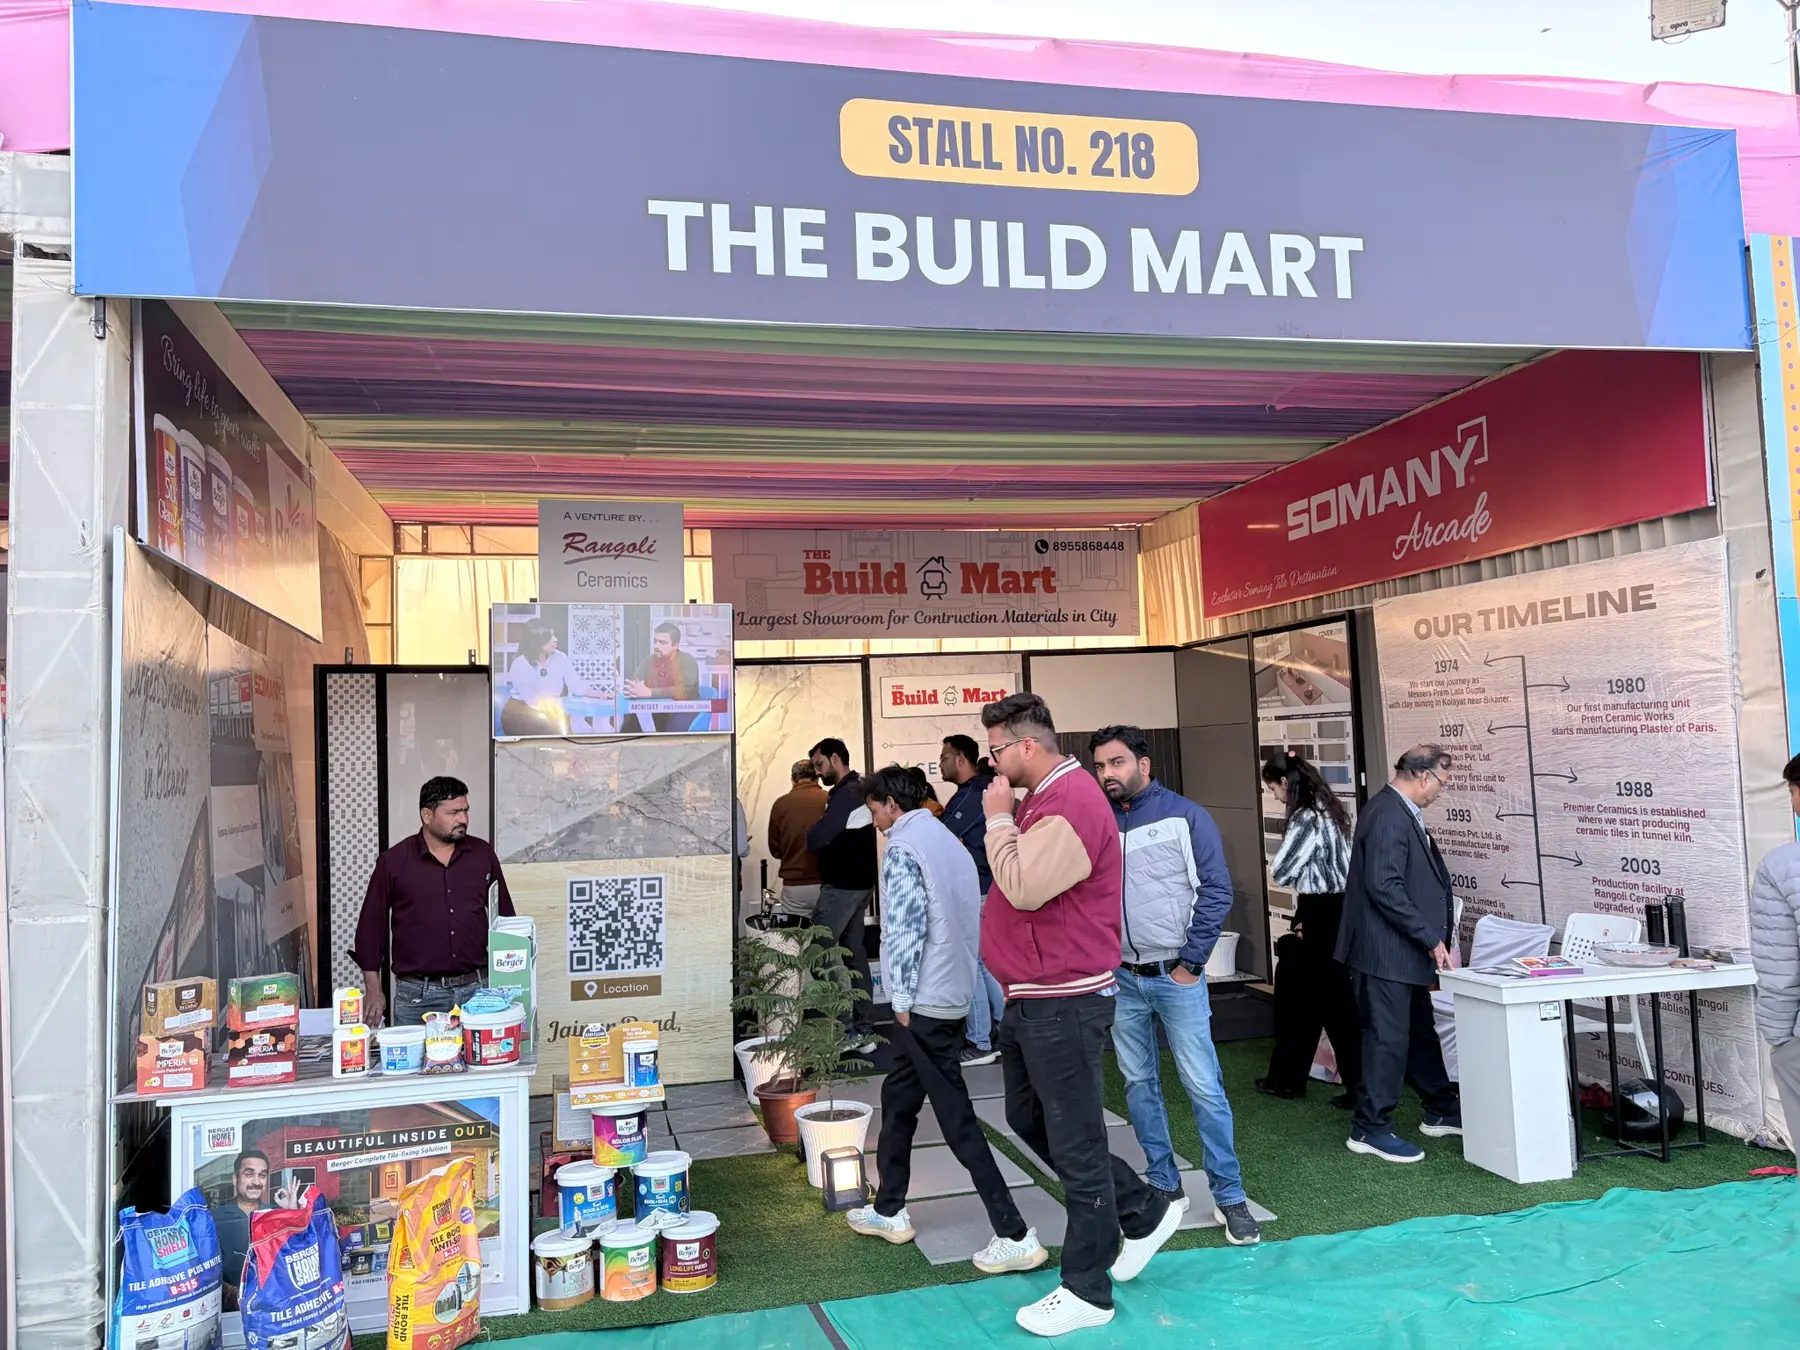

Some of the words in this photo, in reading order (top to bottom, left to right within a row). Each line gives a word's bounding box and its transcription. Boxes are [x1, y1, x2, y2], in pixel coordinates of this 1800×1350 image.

[888, 114, 1003, 172] STALL
[1015, 125, 1077, 175] NO.
[1090, 129, 1155, 181] 218
[648, 199, 827, 279] THE
[854, 211, 1108, 291] BUILD
[1130, 228, 1364, 300] MART
[160, 335, 194, 406] Bring
[194, 371, 210, 419] life
[1286, 434, 1479, 542] SOMANY
[564, 512, 572, 520] A
[575, 513, 626, 522] VENTURE
[1392, 491, 1493, 560] Arcade
[562, 532, 657, 560] Rangoli
[1052, 540, 1125, 553] 8955868448
[803, 550, 830, 560] THE
[577, 570, 648, 588] Ceramics
[803, 562, 907, 595] Build
[960, 562, 1058, 595] Mart
[1290, 565, 1338, 589] Destination
[736, 610, 798, 628] Largest
[802, 610, 884, 626] Showroom
[886, 609, 910, 630] for
[914, 610, 999, 625] Contruction
[1001, 609, 1068, 624] Materials
[1072, 610, 1086, 623] in
[1090, 608, 1118, 627] City
[1414, 612, 1472, 640] OUR
[1477, 584, 1657, 632] TIMELINE
[1434, 659, 1459, 674] 1974
[1420, 680, 1434, 688] start
[1446, 678, 1470, 687] journey
[1472, 676, 1480, 684] as
[1607, 677, 1646, 695] 1980
[892, 689, 939, 706] Build
[962, 688, 1007, 703] Mart
[1408, 690, 1432, 698] Messers
[1433, 688, 1450, 697] Prem
[1450, 688, 1464, 696] Lata
[1466, 686, 1486, 696] Gupta
[1402, 700, 1413, 710] clay
[1414, 700, 1434, 708] mining
[1435, 699, 1442, 707] in
[1442, 697, 1467, 708] Kolayat
[1468, 697, 1482, 705] near
[1566, 703, 1582, 712] Our
[1584, 702, 1600, 712] first
[1602, 700, 1668, 712] manufacturing
[1672, 698, 1690, 708] unit
[1581, 714, 1604, 724] Prem
[1606, 712, 1642, 722] Ceramic
[1644, 712, 1674, 721] Works
[1440, 724, 1464, 738] 1987
[1552, 726, 1574, 736] starts
[1576, 725, 1638, 736] manufacturing
[1640, 724, 1672, 733] Plaster
[1676, 722, 1686, 732] of
[1688, 722, 1717, 732] Paris.
[1470, 742, 1482, 751] unit
[1464, 753, 1478, 761] Pvt.
[1479, 753, 1492, 762] Ltd.
[1454, 775, 1468, 783] very
[1469, 773, 1482, 782] first
[1484, 774, 1496, 782] unit
[1498, 774, 1506, 782] to
[1456, 783, 1468, 791] kiln
[1470, 783, 1476, 791] in
[1478, 784, 1496, 792] India.
[1616, 781, 1653, 798] 1988
[1446, 808, 1472, 822] 1993
[1564, 802, 1594, 812] Premier
[1596, 804, 1638, 815] Ceramics
[1640, 806, 1648, 816] is
[1650, 807, 1706, 819] established
[1578, 815, 1603, 824] where
[1604, 816, 1617, 825] we
[1619, 818, 1640, 827] start
[1642, 819, 1690, 832] producing
[1438, 828, 1466, 838] Ceramics
[1468, 830, 1480, 839] Pvt.
[1481, 831, 1494, 840] Ltd.
[1496, 832, 1502, 841] is
[1576, 826, 1608, 837] ceramic
[1610, 828, 1629, 838] tiles
[1631, 830, 1640, 839] in
[1642, 831, 1672, 841] tunnel
[1674, 832, 1694, 843] kiln.
[1443, 838, 1450, 846] to
[1452, 840, 1491, 850] manufacture
[1492, 842, 1510, 854] large
[1448, 849, 1473, 858] ceramic
[1474, 850, 1490, 860] tiles.
[1620, 857, 1661, 876] 2003
[1452, 874, 1478, 890] 2016
[1592, 876, 1639, 891] Production
[1642, 882, 1673, 896] facility
[1674, 887, 1684, 897] at
[1594, 889, 1628, 901] Rangoli
[1474, 896, 1498, 908] Limited
[1499, 900, 1506, 909] is
[1594, 900, 1634, 914] upgraded
[496, 958, 525, 969] Berger
[604, 982, 648, 994] Location
[1674, 992, 1684, 1002] of
[248, 1045, 274, 1054] IMPERIA
[156, 1058, 187, 1068] IMPERIA
[1664, 1070, 1734, 1098] CONTIUES...
[208, 1126, 234, 1134] BERGER
[212, 1132, 232, 1142] HOME
[212, 1140, 232, 1148] SHIELD
[294, 1136, 384, 1154] BEAUTIFUL
[392, 1128, 448, 1144] INSIDE
[454, 1124, 485, 1138] OUT
[612, 1137, 630, 1145] KOLOR
[330, 1159, 353, 1169] Berger
[354, 1154, 386, 1166] Complete
[387, 1149, 418, 1163] Tile-fixing
[420, 1144, 448, 1156] Solution
[430, 1234, 444, 1246] TILE
[157, 1238, 187, 1258] SHIELD
[678, 1249, 697, 1258] Berger
[630, 1255, 648, 1264] Berger
[128, 1282, 146, 1292] TILE
[149, 1272, 186, 1288] ADHSIVE
[202, 1255, 222, 1269] WHITE
[684, 1264, 694, 1272] LIFE
[170, 1280, 198, 1296] B-315
[270, 1308, 292, 1322] TILE
[394, 1295, 402, 1340] ANTI-SLIP
[400, 1314, 408, 1342] BOND
